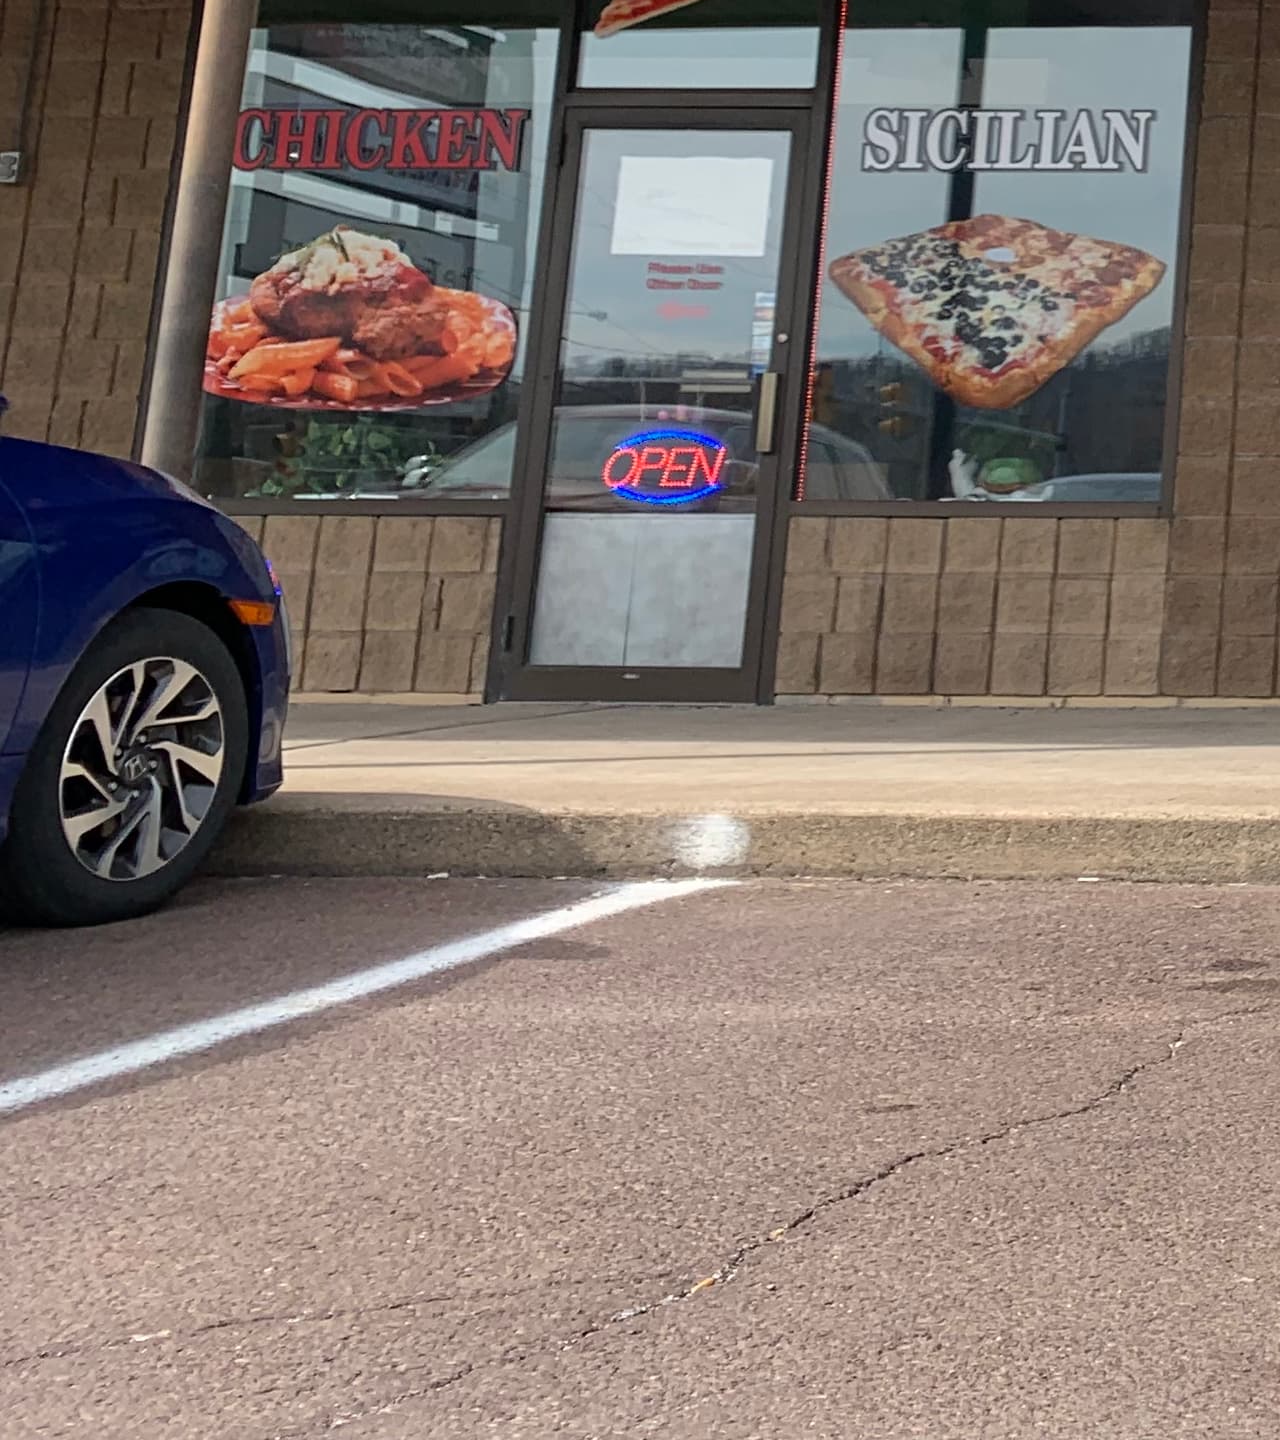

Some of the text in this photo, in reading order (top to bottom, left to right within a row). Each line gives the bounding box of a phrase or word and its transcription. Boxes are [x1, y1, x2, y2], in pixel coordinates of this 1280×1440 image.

[233, 107, 531, 172] CHICKEN
[861, 107, 1157, 173] SICILIAN
[602, 446, 727, 490] OPEN
